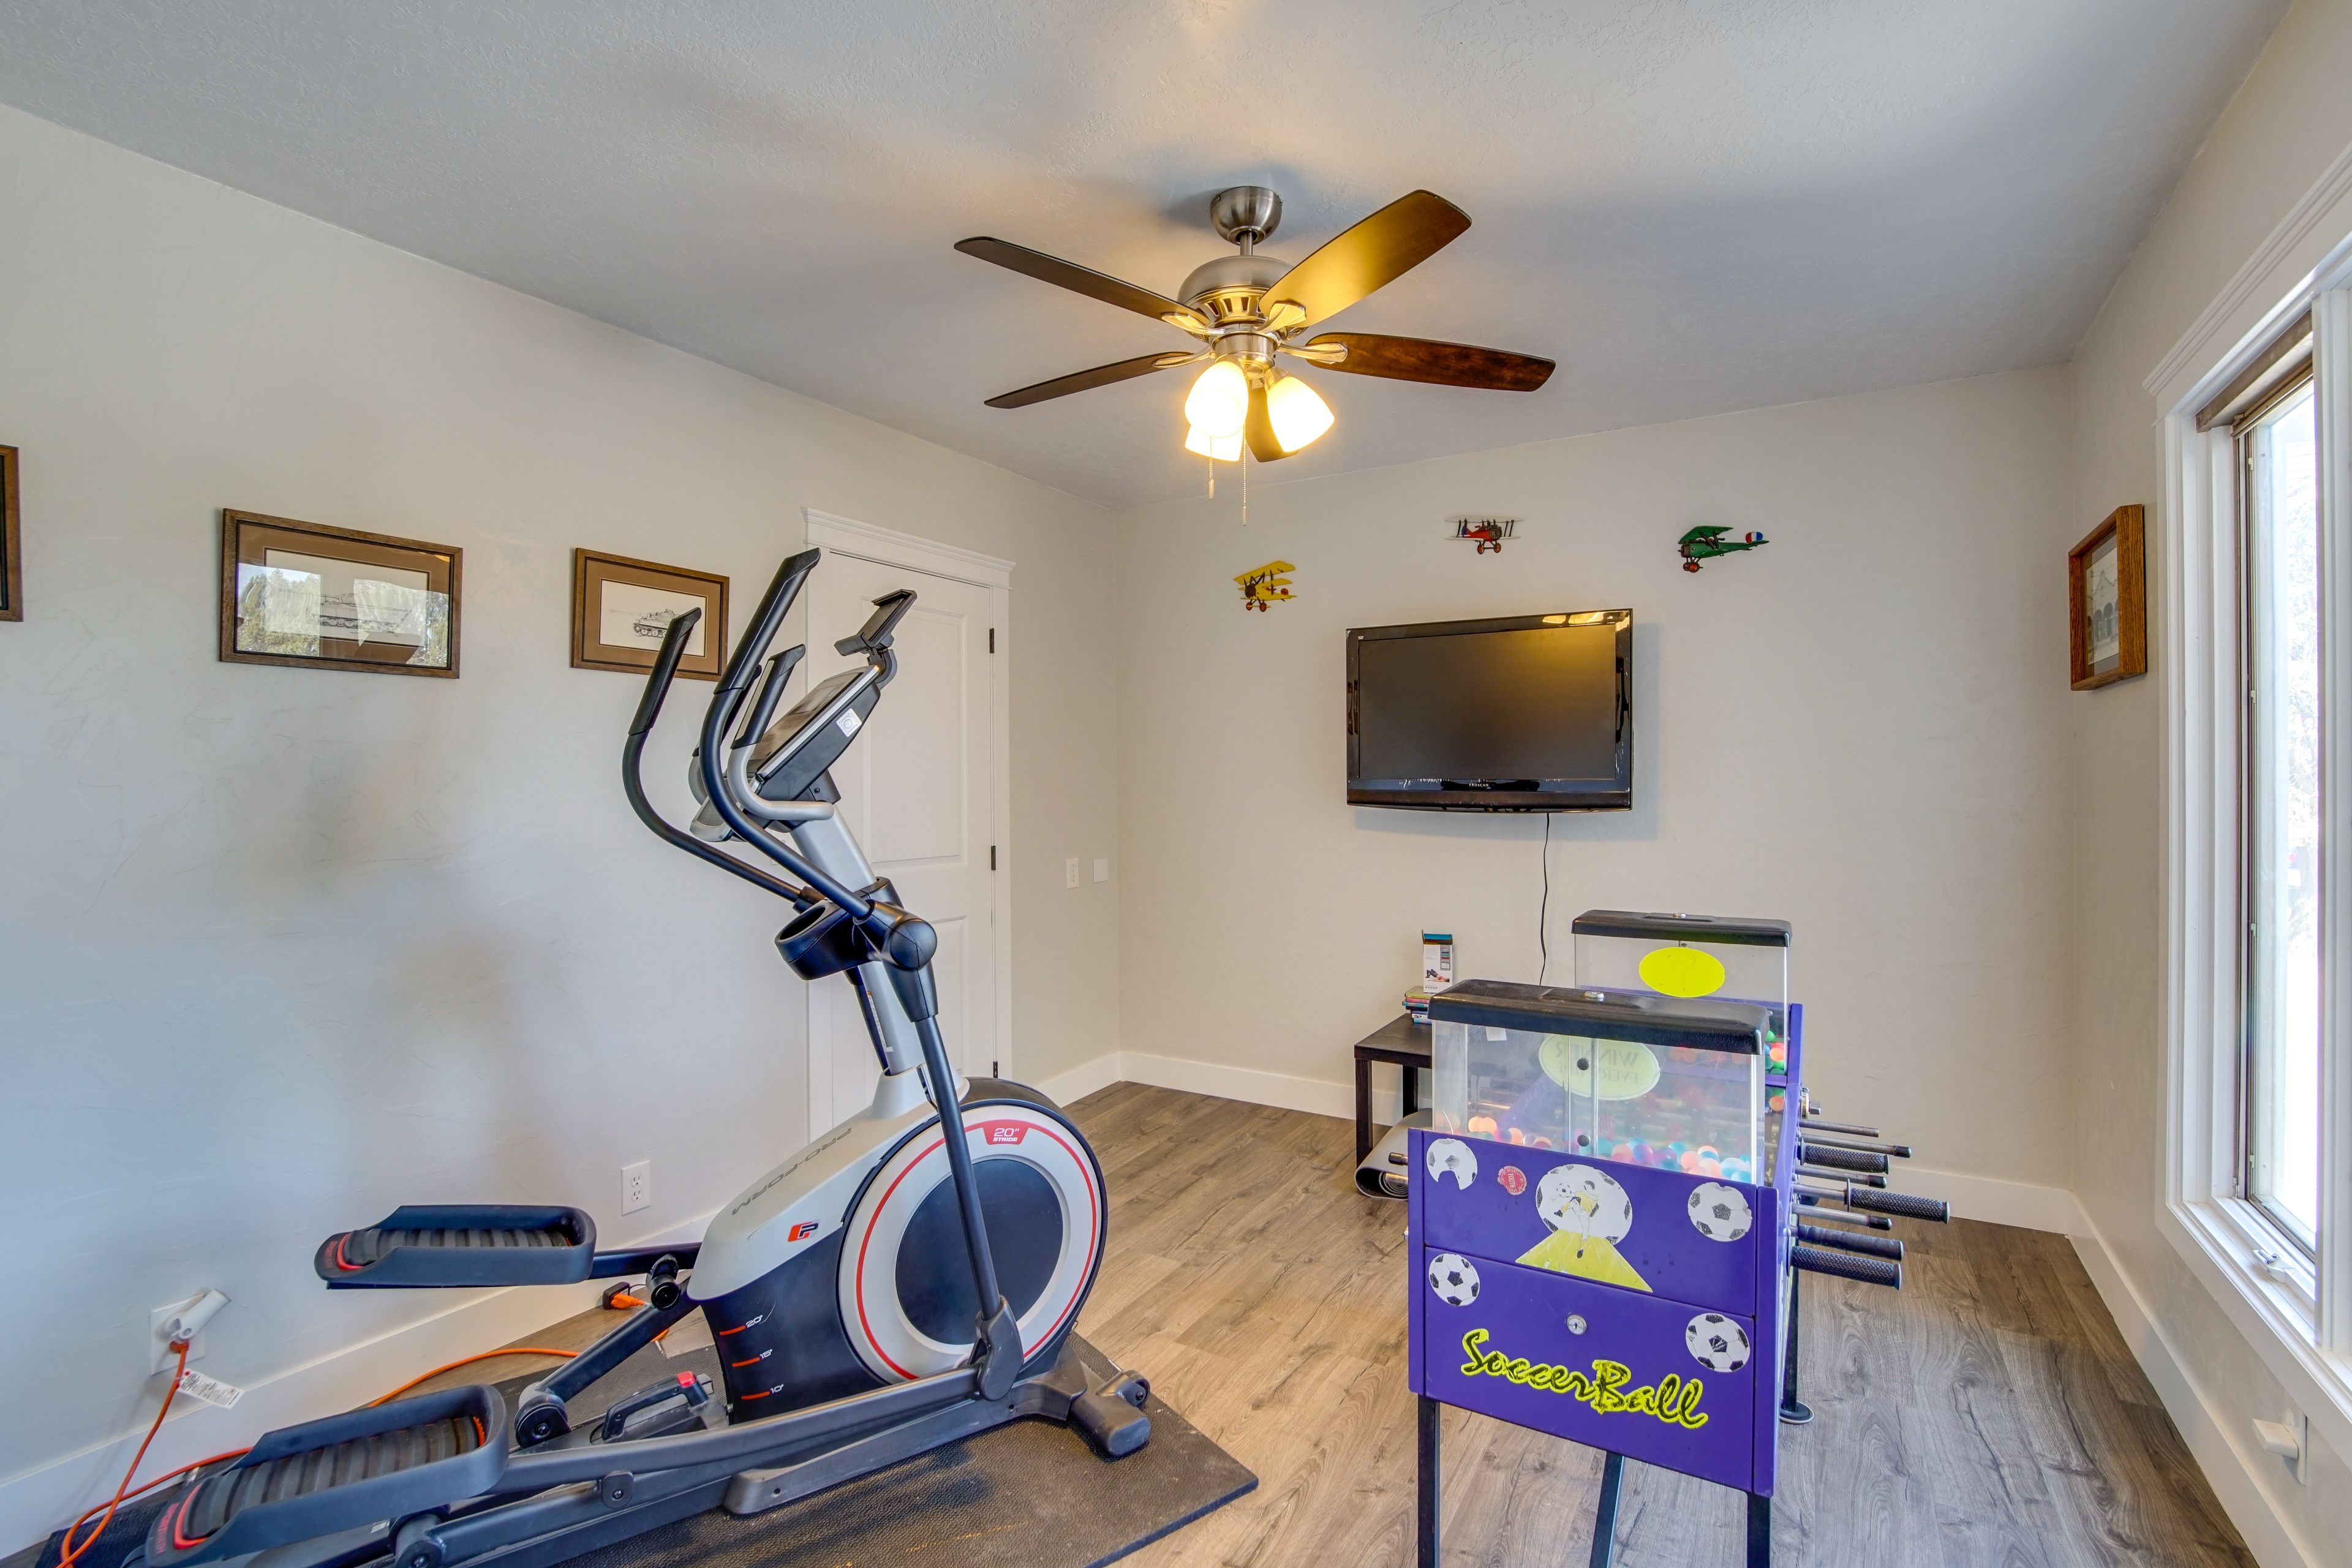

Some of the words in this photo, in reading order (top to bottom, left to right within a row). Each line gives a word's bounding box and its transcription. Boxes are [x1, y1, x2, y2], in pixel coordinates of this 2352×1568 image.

[993, 1128, 1020, 1137] 20"
[732, 1127, 851, 1215] PRO-FORM
[1507, 1172, 1517, 1188] YOUTH
[1461, 1328, 1709, 1429] SoccerBall
